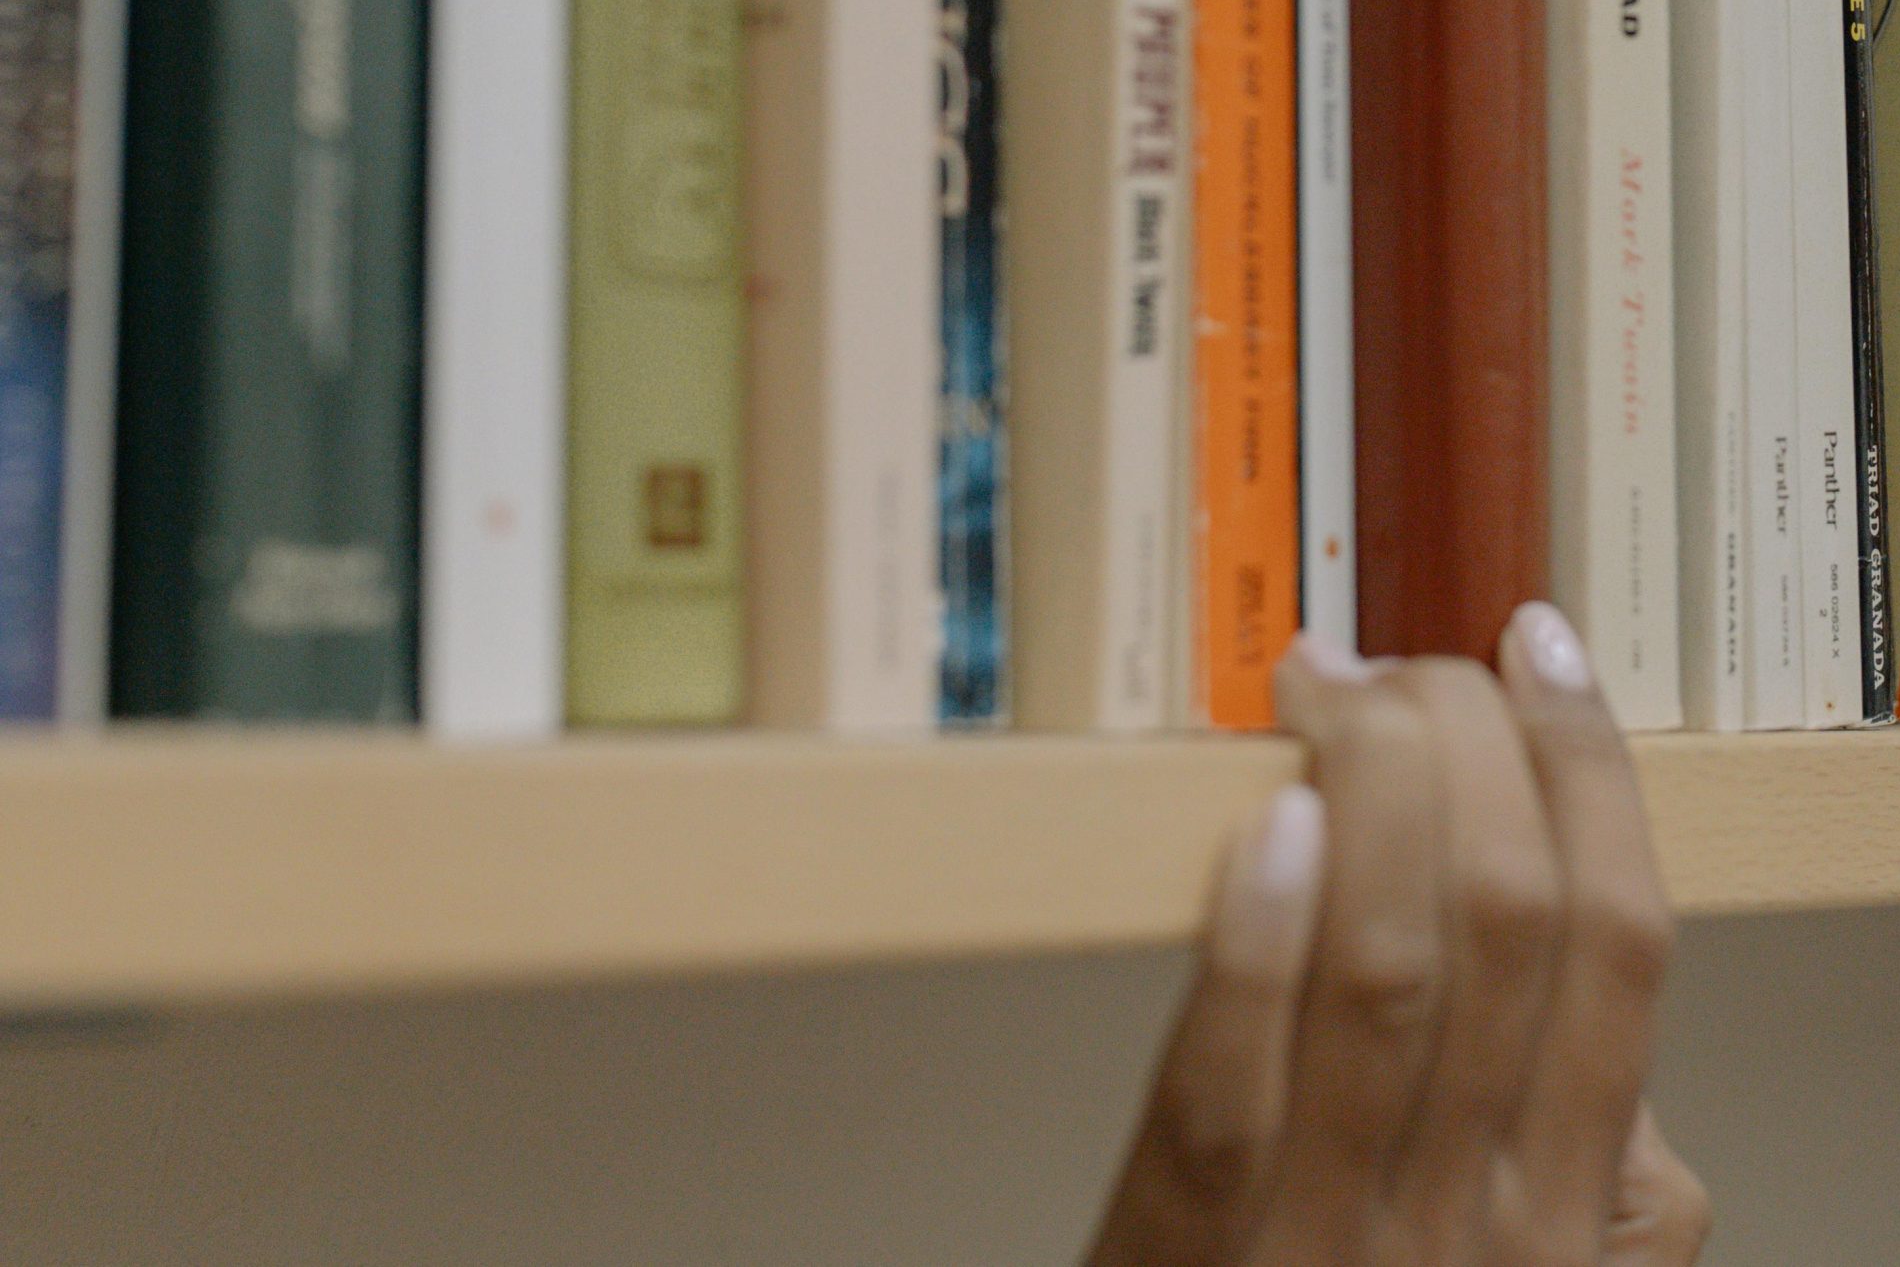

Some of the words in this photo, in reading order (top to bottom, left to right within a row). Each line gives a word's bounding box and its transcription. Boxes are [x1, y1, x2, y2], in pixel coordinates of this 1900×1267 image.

[1850, 22, 1866, 43] 5
[1824, 431, 1841, 531] Panther
[1867, 444, 1881, 537] TRIAD
[1871, 548, 1886, 691] GRANADA
